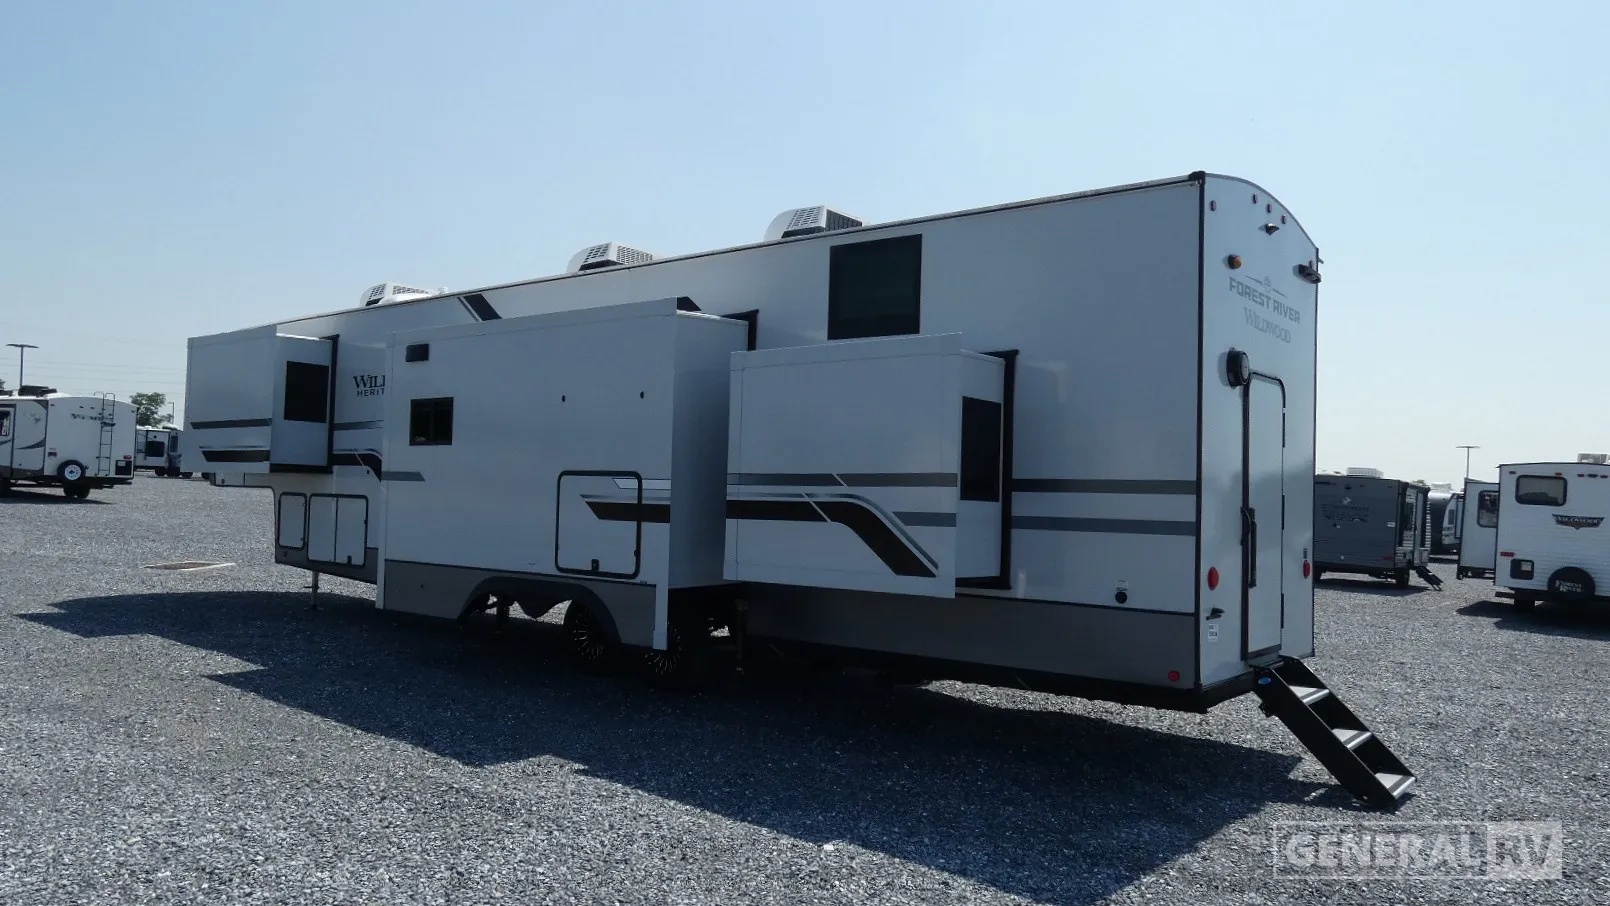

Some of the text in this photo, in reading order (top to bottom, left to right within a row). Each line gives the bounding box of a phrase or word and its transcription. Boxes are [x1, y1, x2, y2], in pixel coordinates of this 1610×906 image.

[1229, 276, 1301, 325] FOREST RIVER
[1243, 306, 1292, 344] WILDWOOD
